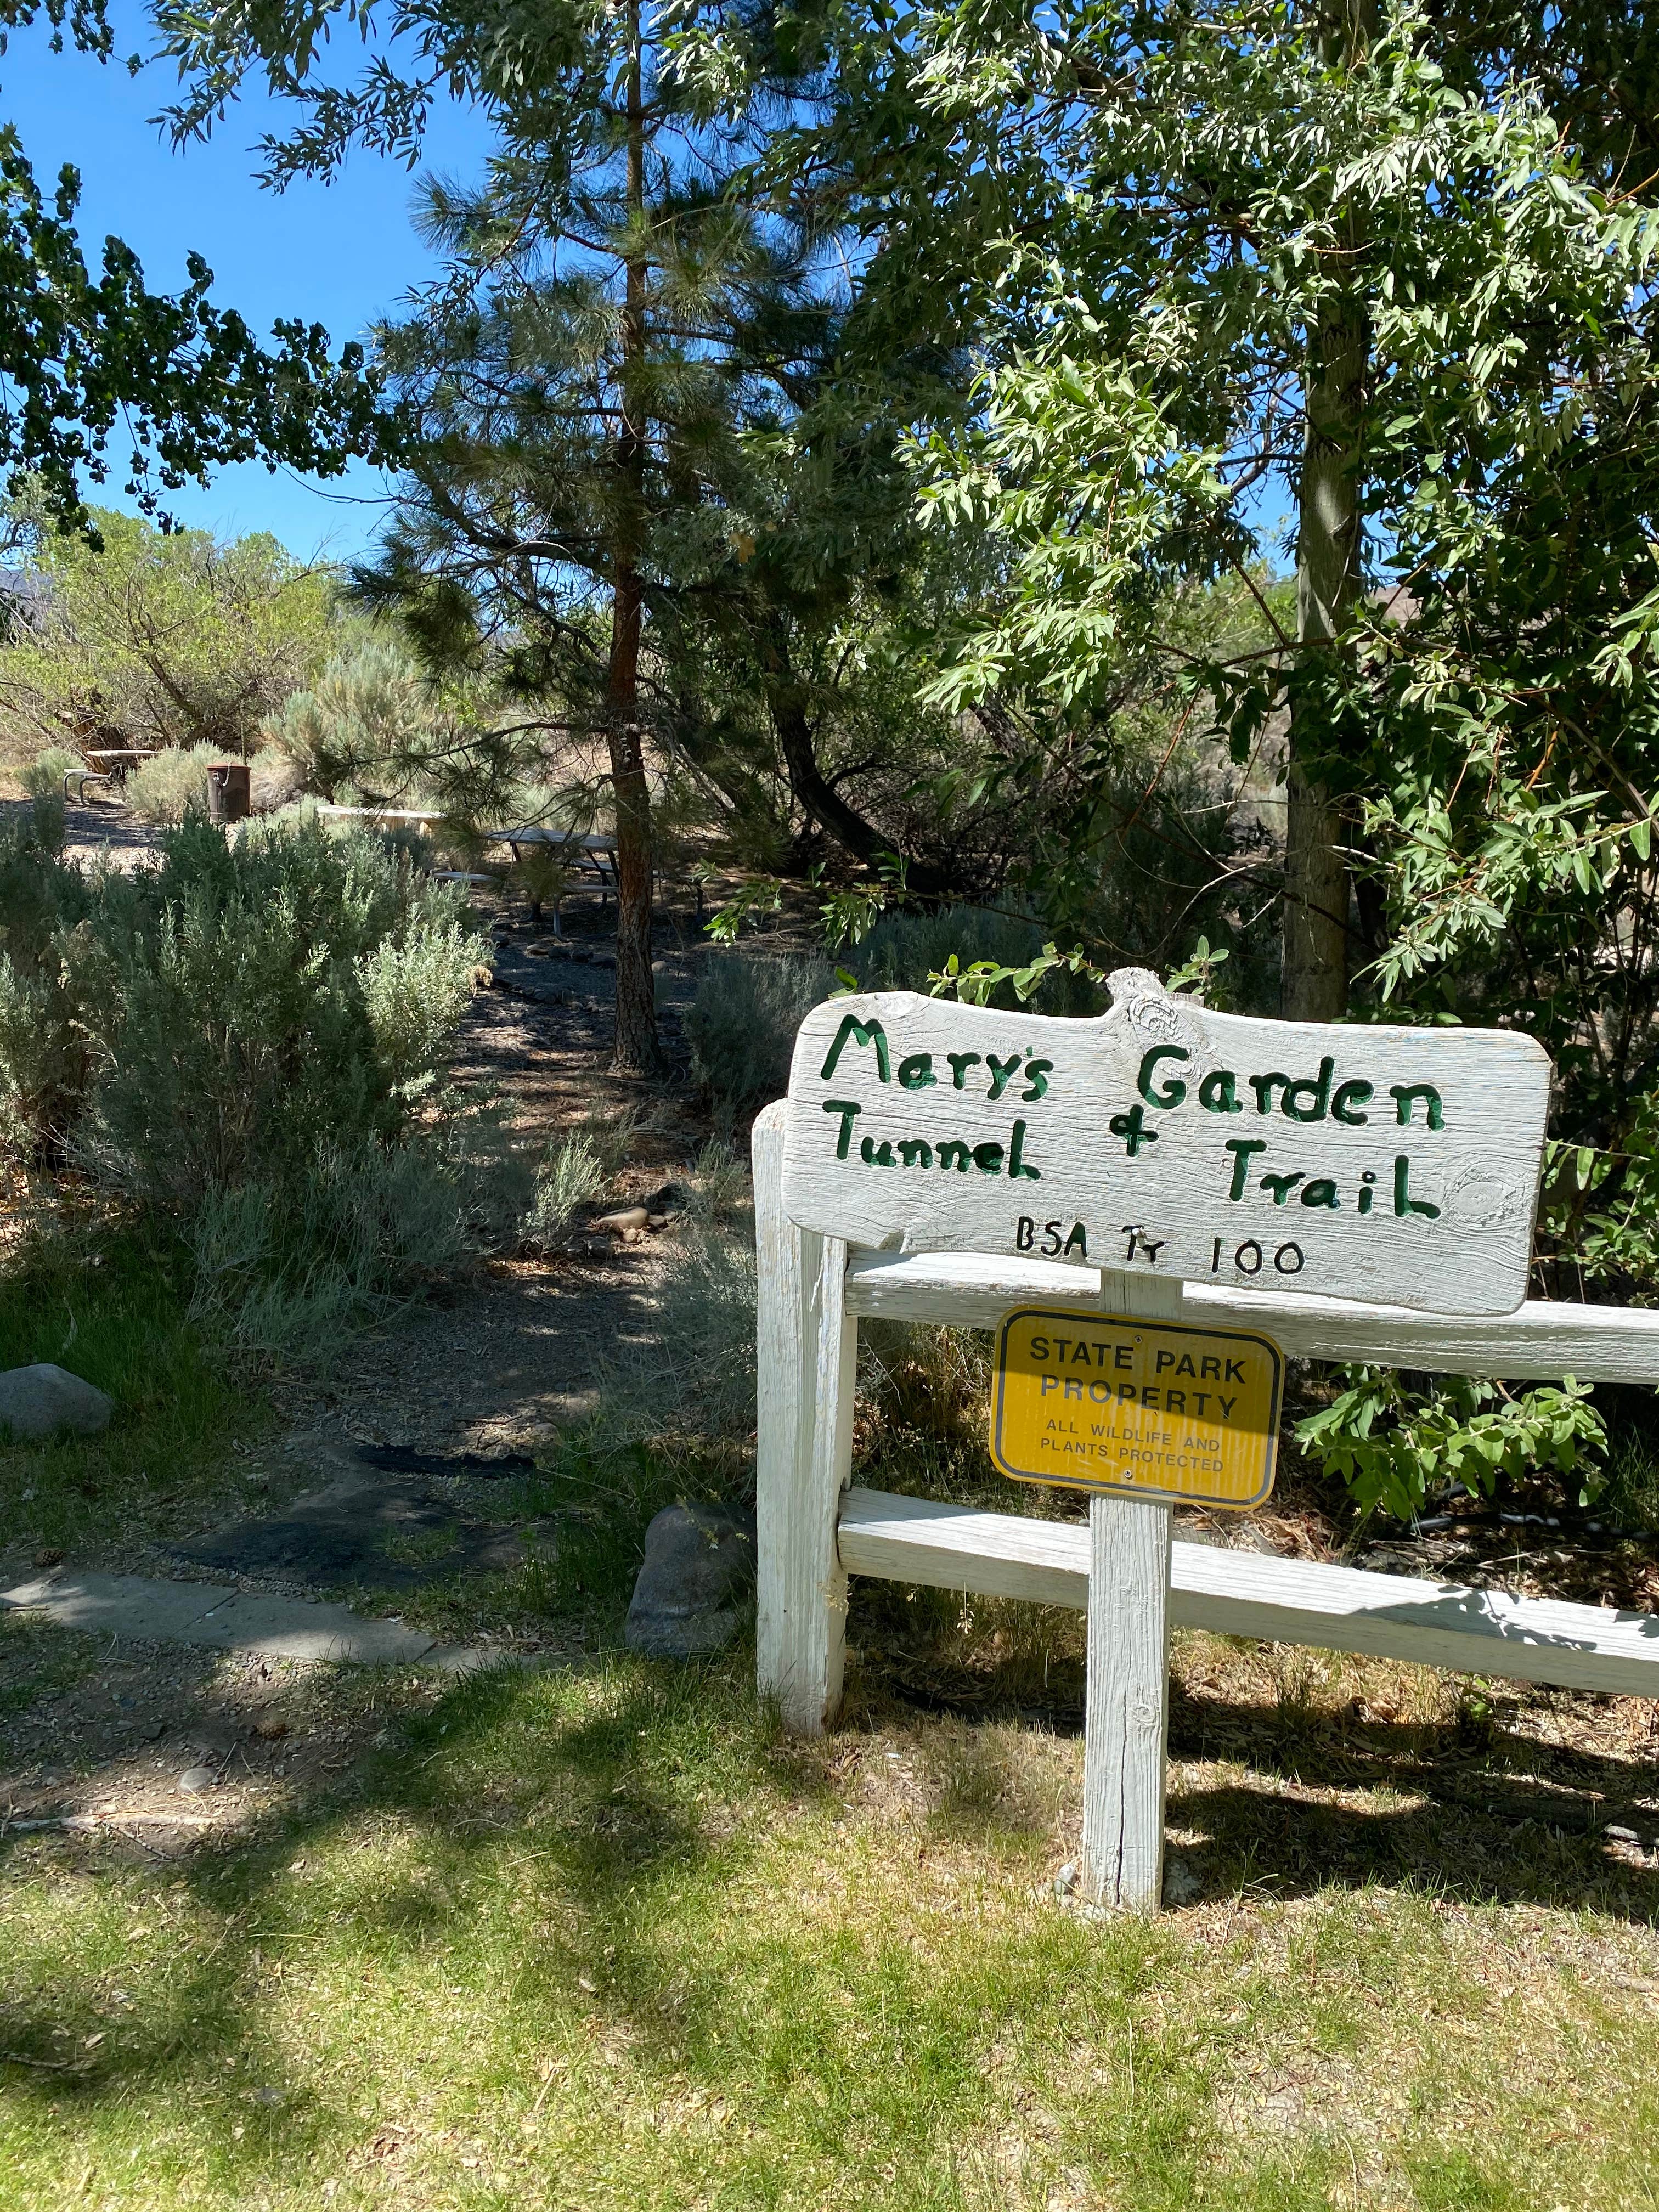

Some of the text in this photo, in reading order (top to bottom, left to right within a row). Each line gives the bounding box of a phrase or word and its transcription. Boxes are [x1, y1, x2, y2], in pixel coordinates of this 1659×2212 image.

[820, 1013, 1446, 1131] Mary's Garden
[821, 1099, 1041, 1181] Tunnel
[1225, 1139, 1442, 1220] Trail
[1016, 1216, 1088, 1259] BSA
[1211, 1237, 1305, 1276] 100
[1030, 1336, 1246, 1384] STATE PARK
[1042, 1374, 1238, 1419] PROPERTY
[1041, 1438, 1224, 1472] PLANTS PROTECTED
[1046, 1419, 1220, 1452] ALL WILDLIFE AND
